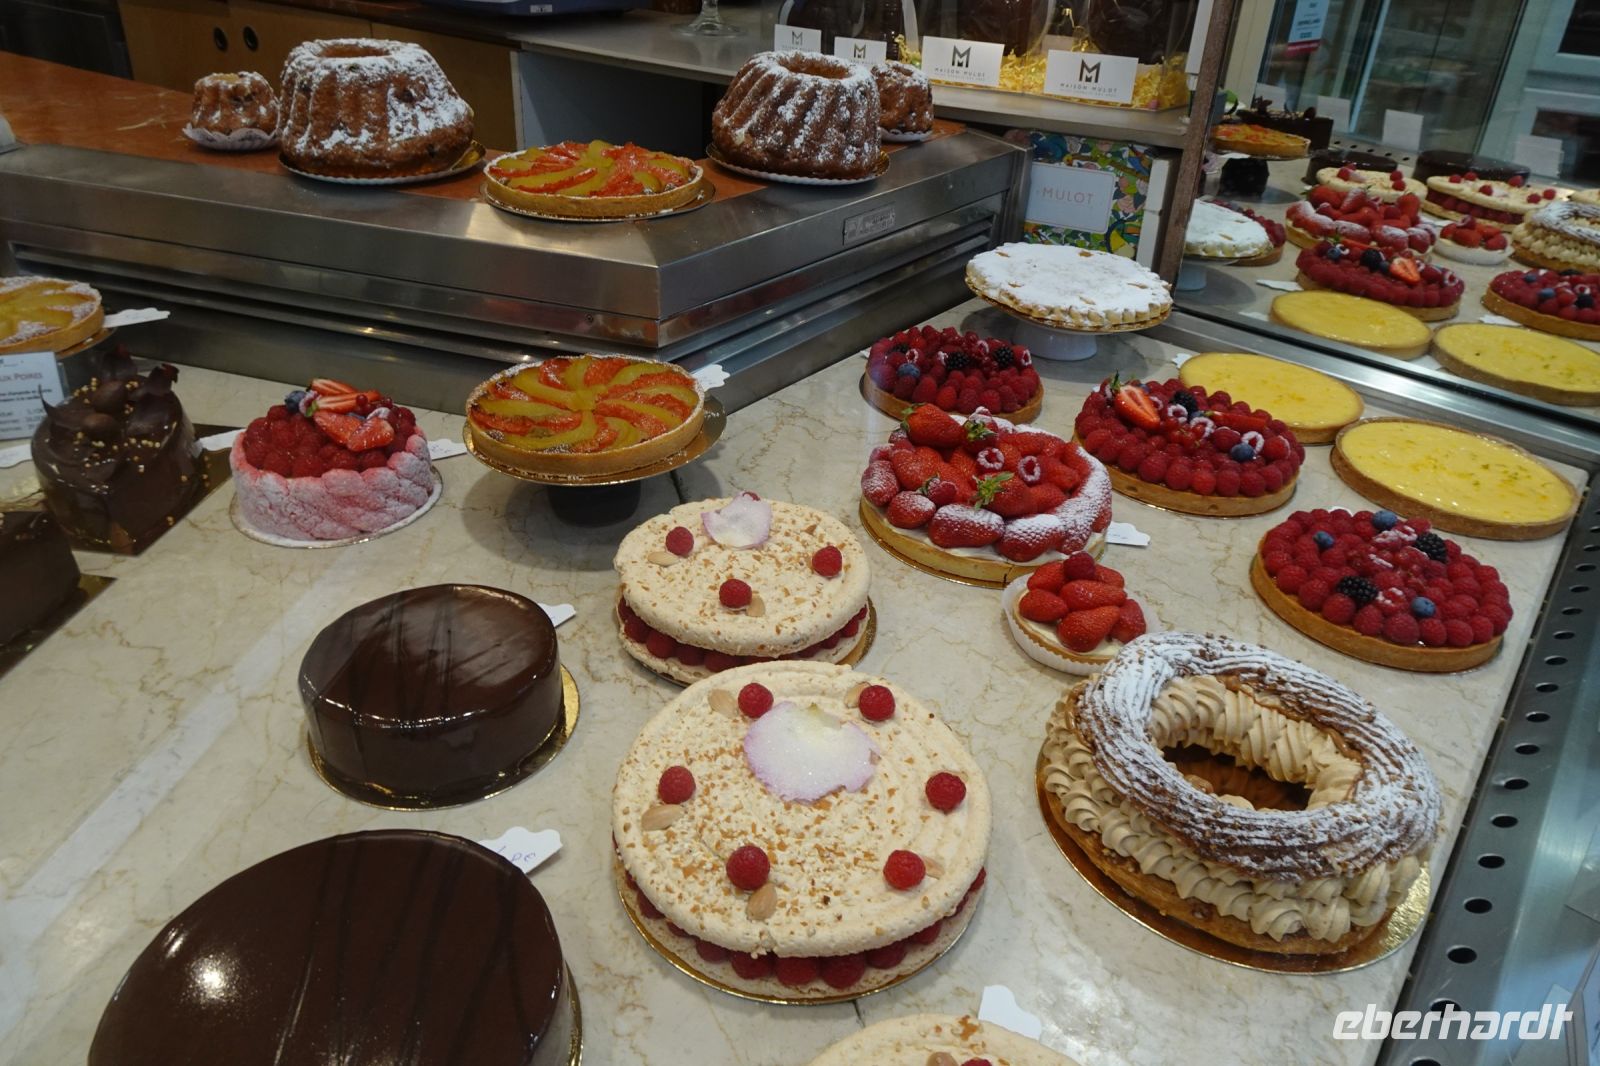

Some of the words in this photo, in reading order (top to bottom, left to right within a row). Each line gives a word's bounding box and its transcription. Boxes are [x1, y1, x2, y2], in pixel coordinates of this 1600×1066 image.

[951, 45, 971, 68] M
[934, 67, 960, 75] MAISON
[1079, 59, 1101, 83] M
[1060, 82, 1088, 90] MAISON
[1042, 186, 1094, 204] MULOT
